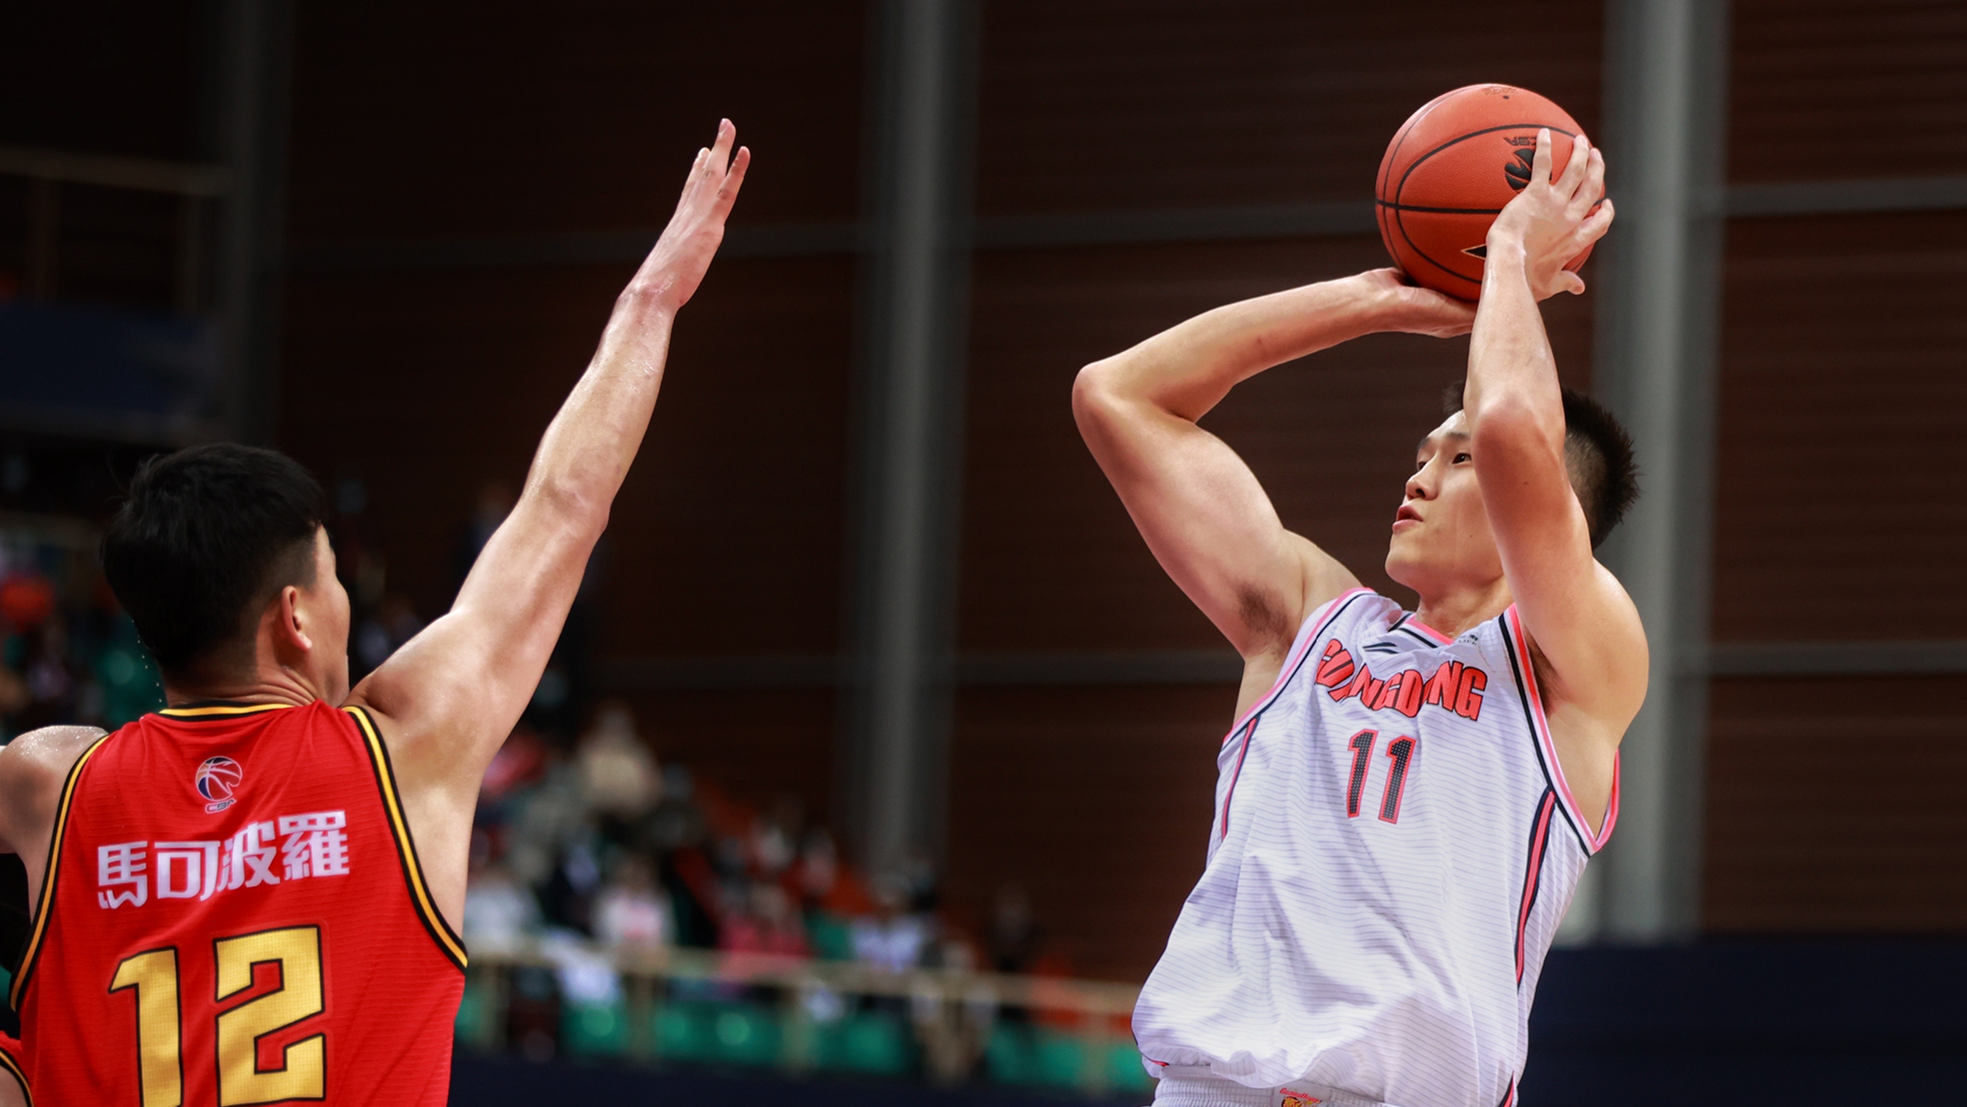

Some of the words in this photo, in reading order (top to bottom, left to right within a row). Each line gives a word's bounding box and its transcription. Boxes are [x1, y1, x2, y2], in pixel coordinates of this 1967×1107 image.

[205, 798, 237, 814] CBA
[1346, 729, 1417, 825] 11
[98, 810, 350, 910] 馬可波羅
[108, 924, 327, 1107] 12
